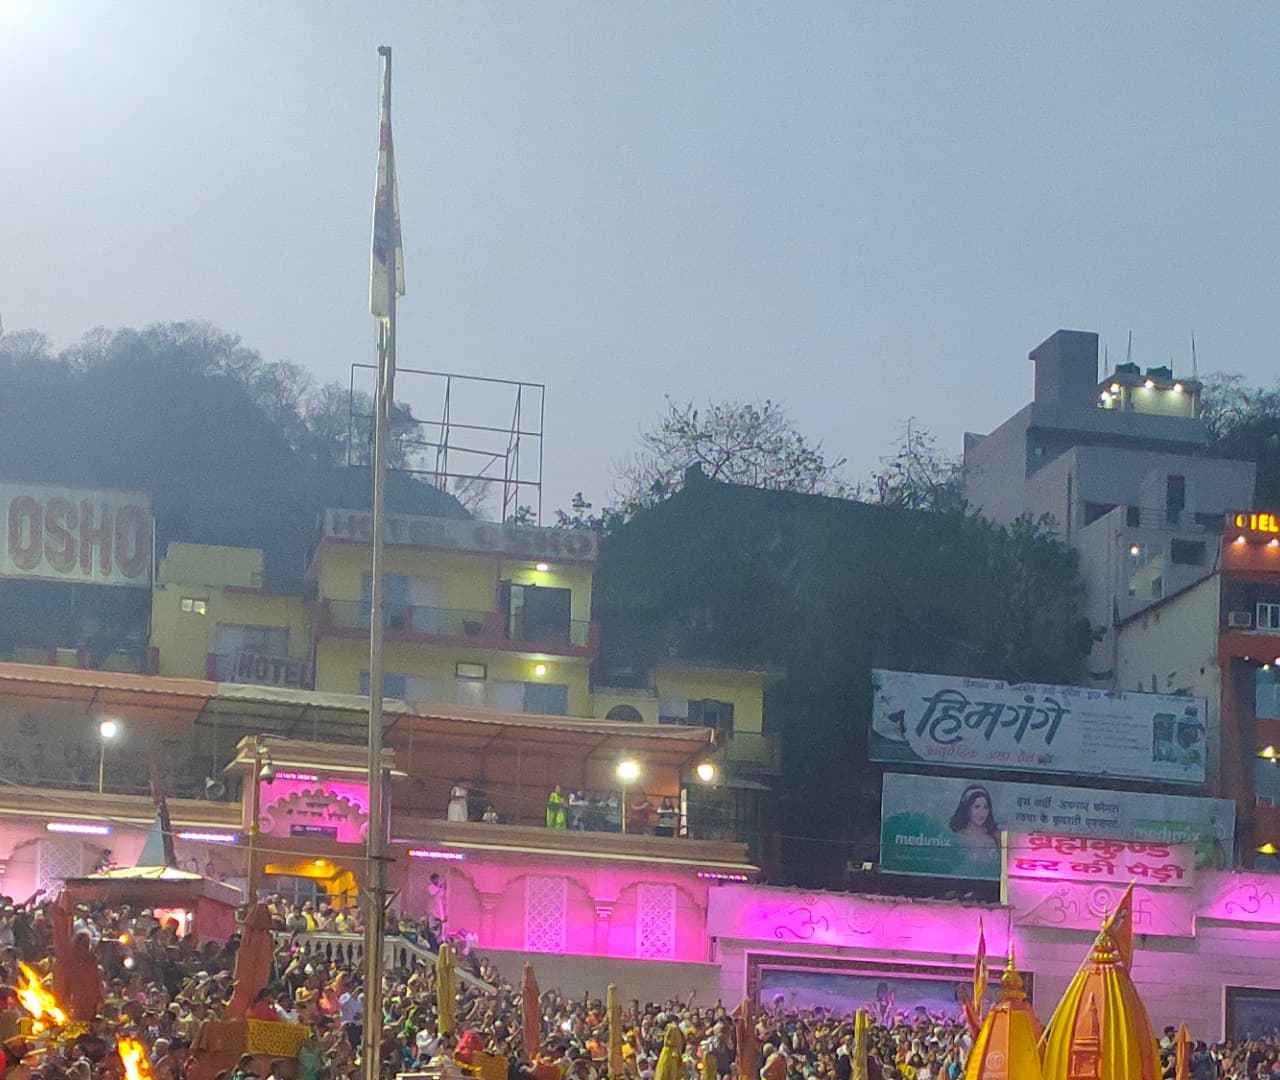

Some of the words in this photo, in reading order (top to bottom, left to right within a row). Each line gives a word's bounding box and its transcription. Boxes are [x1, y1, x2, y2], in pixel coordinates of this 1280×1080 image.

[8, 496, 148, 578] OSHO
[915, 688, 1071, 746] हिमगंगे
[895, 833, 952, 848] medimix
[1014, 858, 1064, 872] हर
[1069, 859, 1118, 876] की
